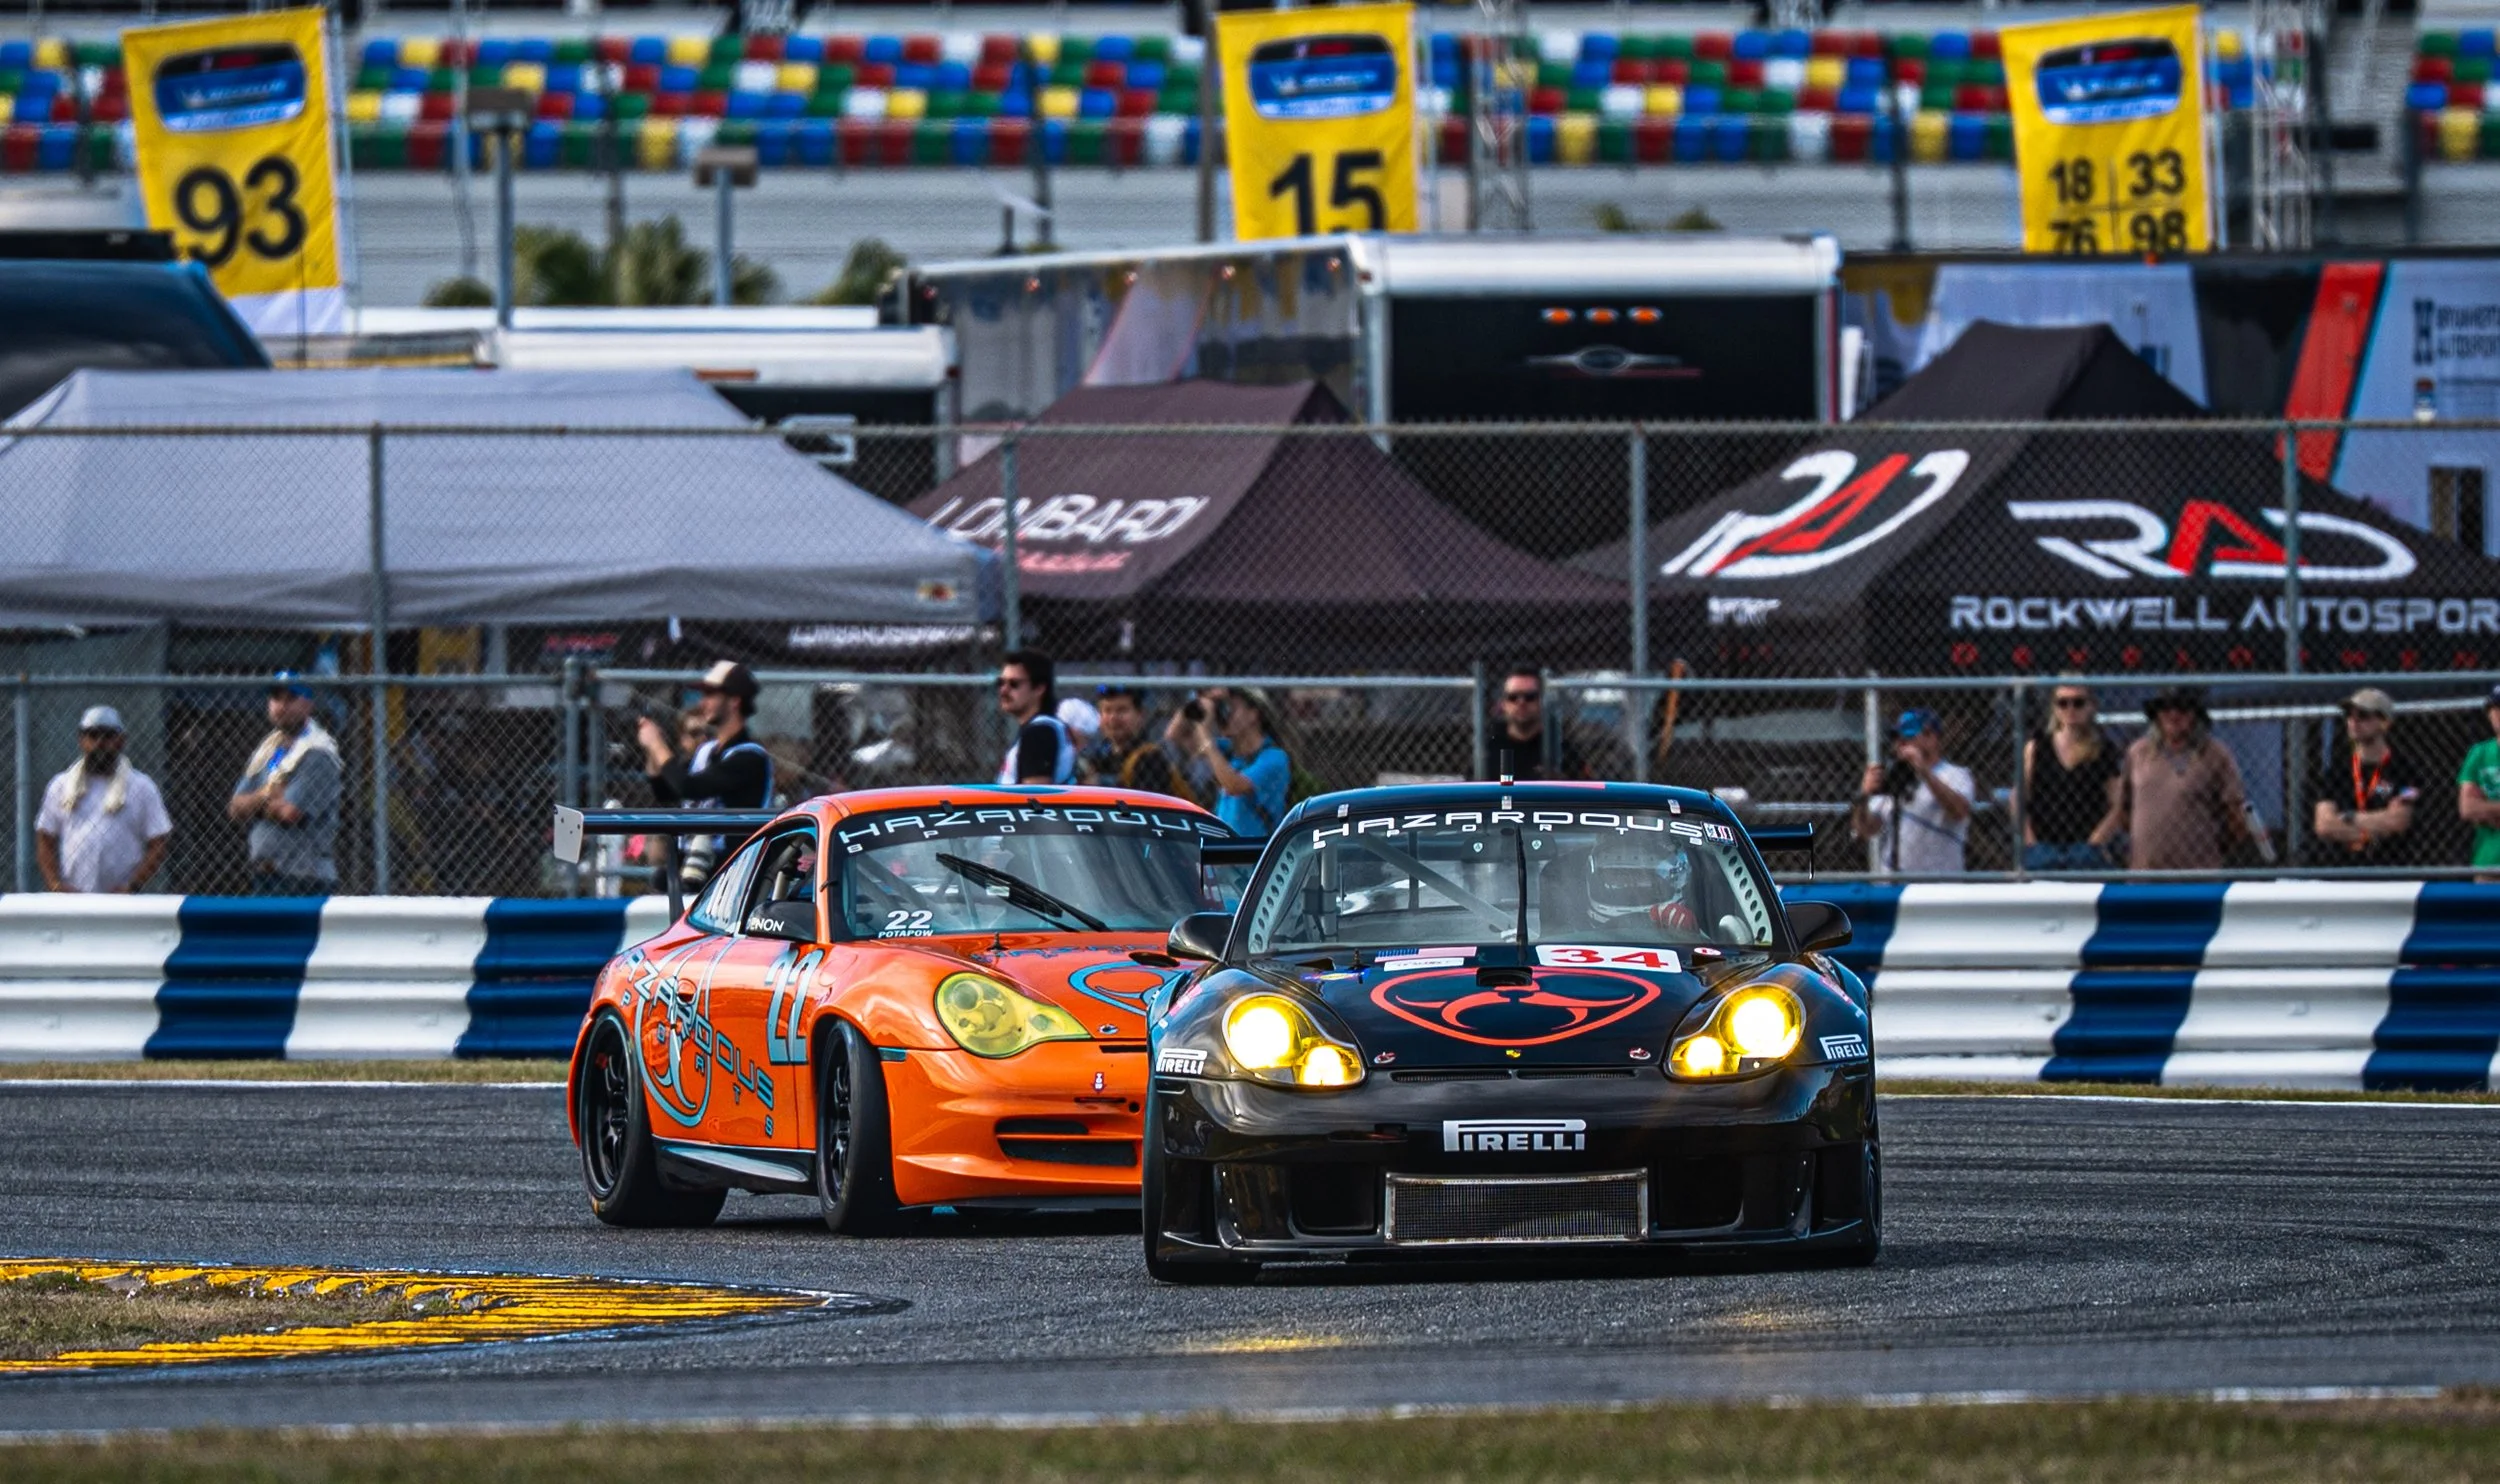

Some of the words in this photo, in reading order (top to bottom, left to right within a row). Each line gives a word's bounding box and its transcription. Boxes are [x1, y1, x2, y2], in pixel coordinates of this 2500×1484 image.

[1269, 150, 1387, 234] 15
[2050, 157, 2094, 203] 18
[2127, 148, 2186, 196] 33
[174, 155, 307, 267] 93
[2050, 217, 2099, 254] 76
[2131, 211, 2187, 254] 98
[2007, 499, 2418, 581] RAD
[1950, 596, 2229, 631] ROCKWELL
[838, 809, 1230, 844] HAZARDOUS
[1313, 811, 1702, 842] HAZARDOUS
[878, 930, 934, 938] POTAPOW
[885, 910, 932, 930] 22
[1550, 949, 1669, 968] 34
[765, 949, 824, 1065] 22
[1156, 1047, 1208, 1075] PIRELLI
[1819, 1034, 1868, 1060] PIRELLI
[1442, 1119, 1587, 1152] PIRELLI
